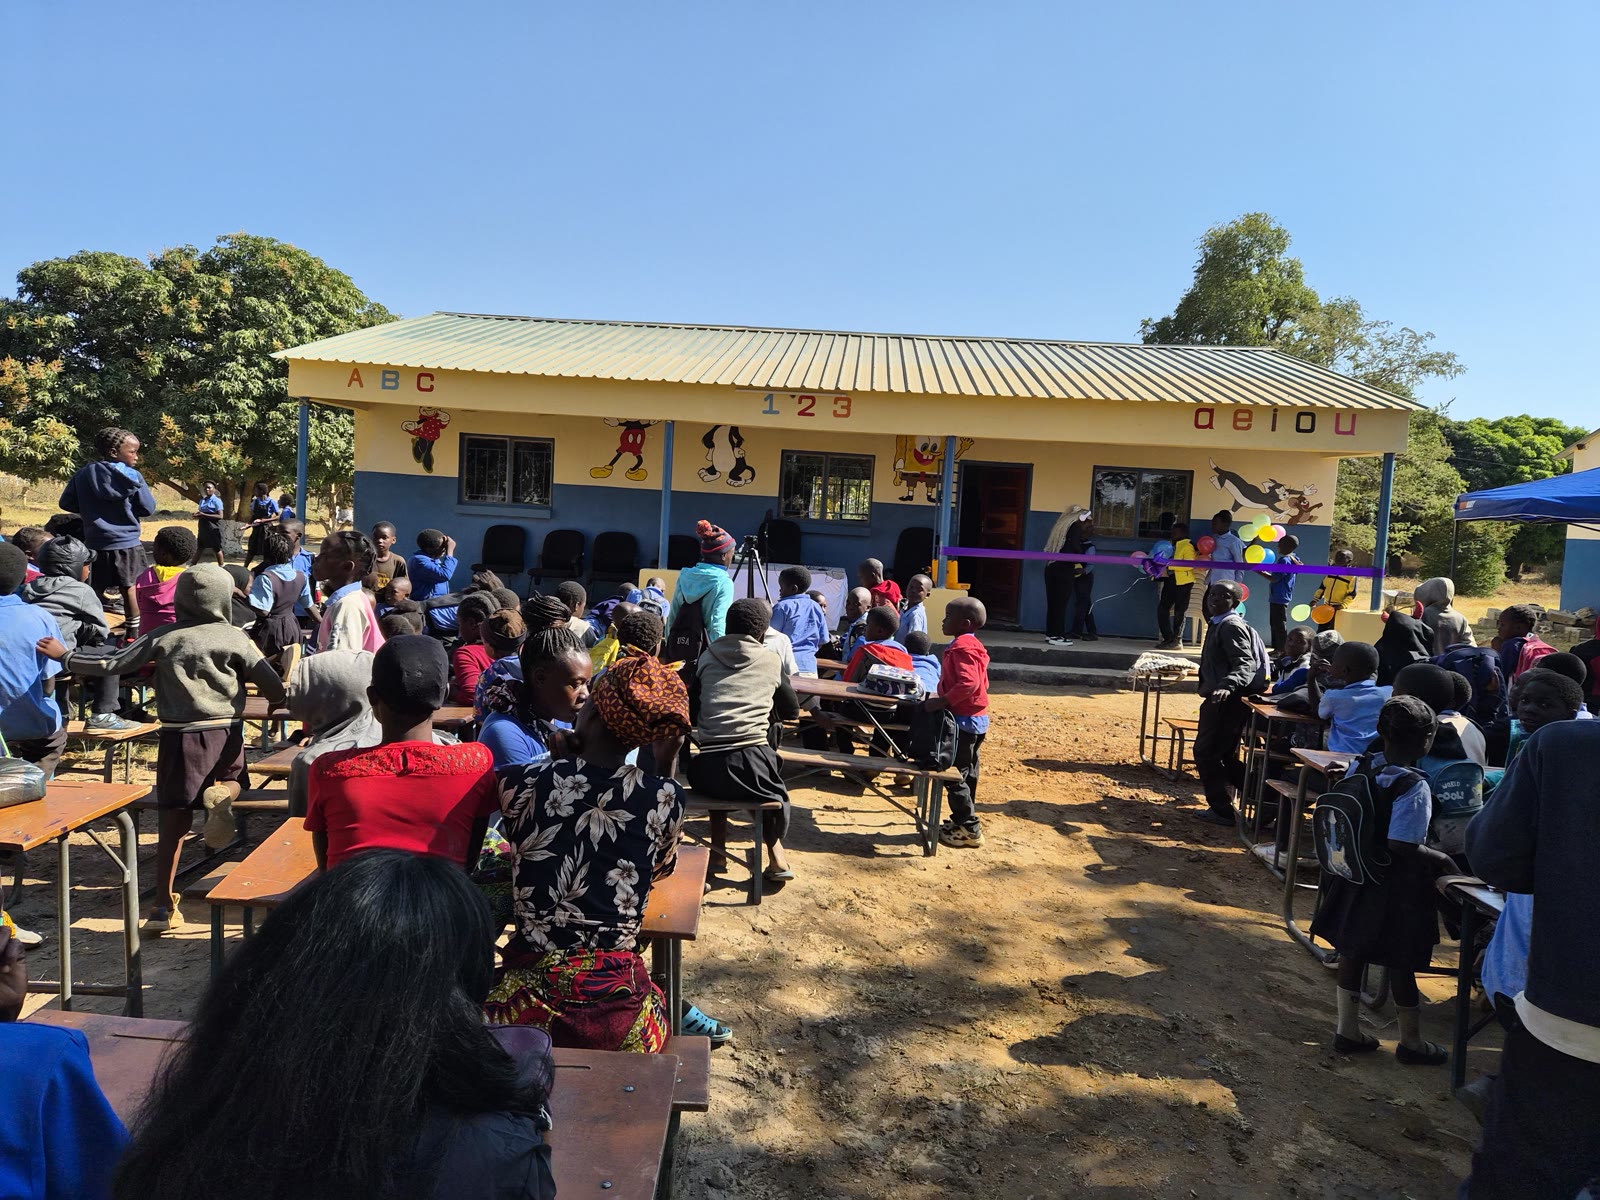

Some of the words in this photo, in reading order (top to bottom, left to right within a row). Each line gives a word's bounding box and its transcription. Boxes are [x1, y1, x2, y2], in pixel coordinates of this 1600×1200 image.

[347, 367, 364, 388] A
[381, 369, 400, 391] B
[416, 372, 435, 392] C
[762, 393, 780, 415] 1
[797, 395, 817, 417] 2
[832, 396, 852, 418] 3
[1232, 408, 1253, 431] e
[1271, 407, 1279, 432] i
[677, 636, 690, 646] USA
